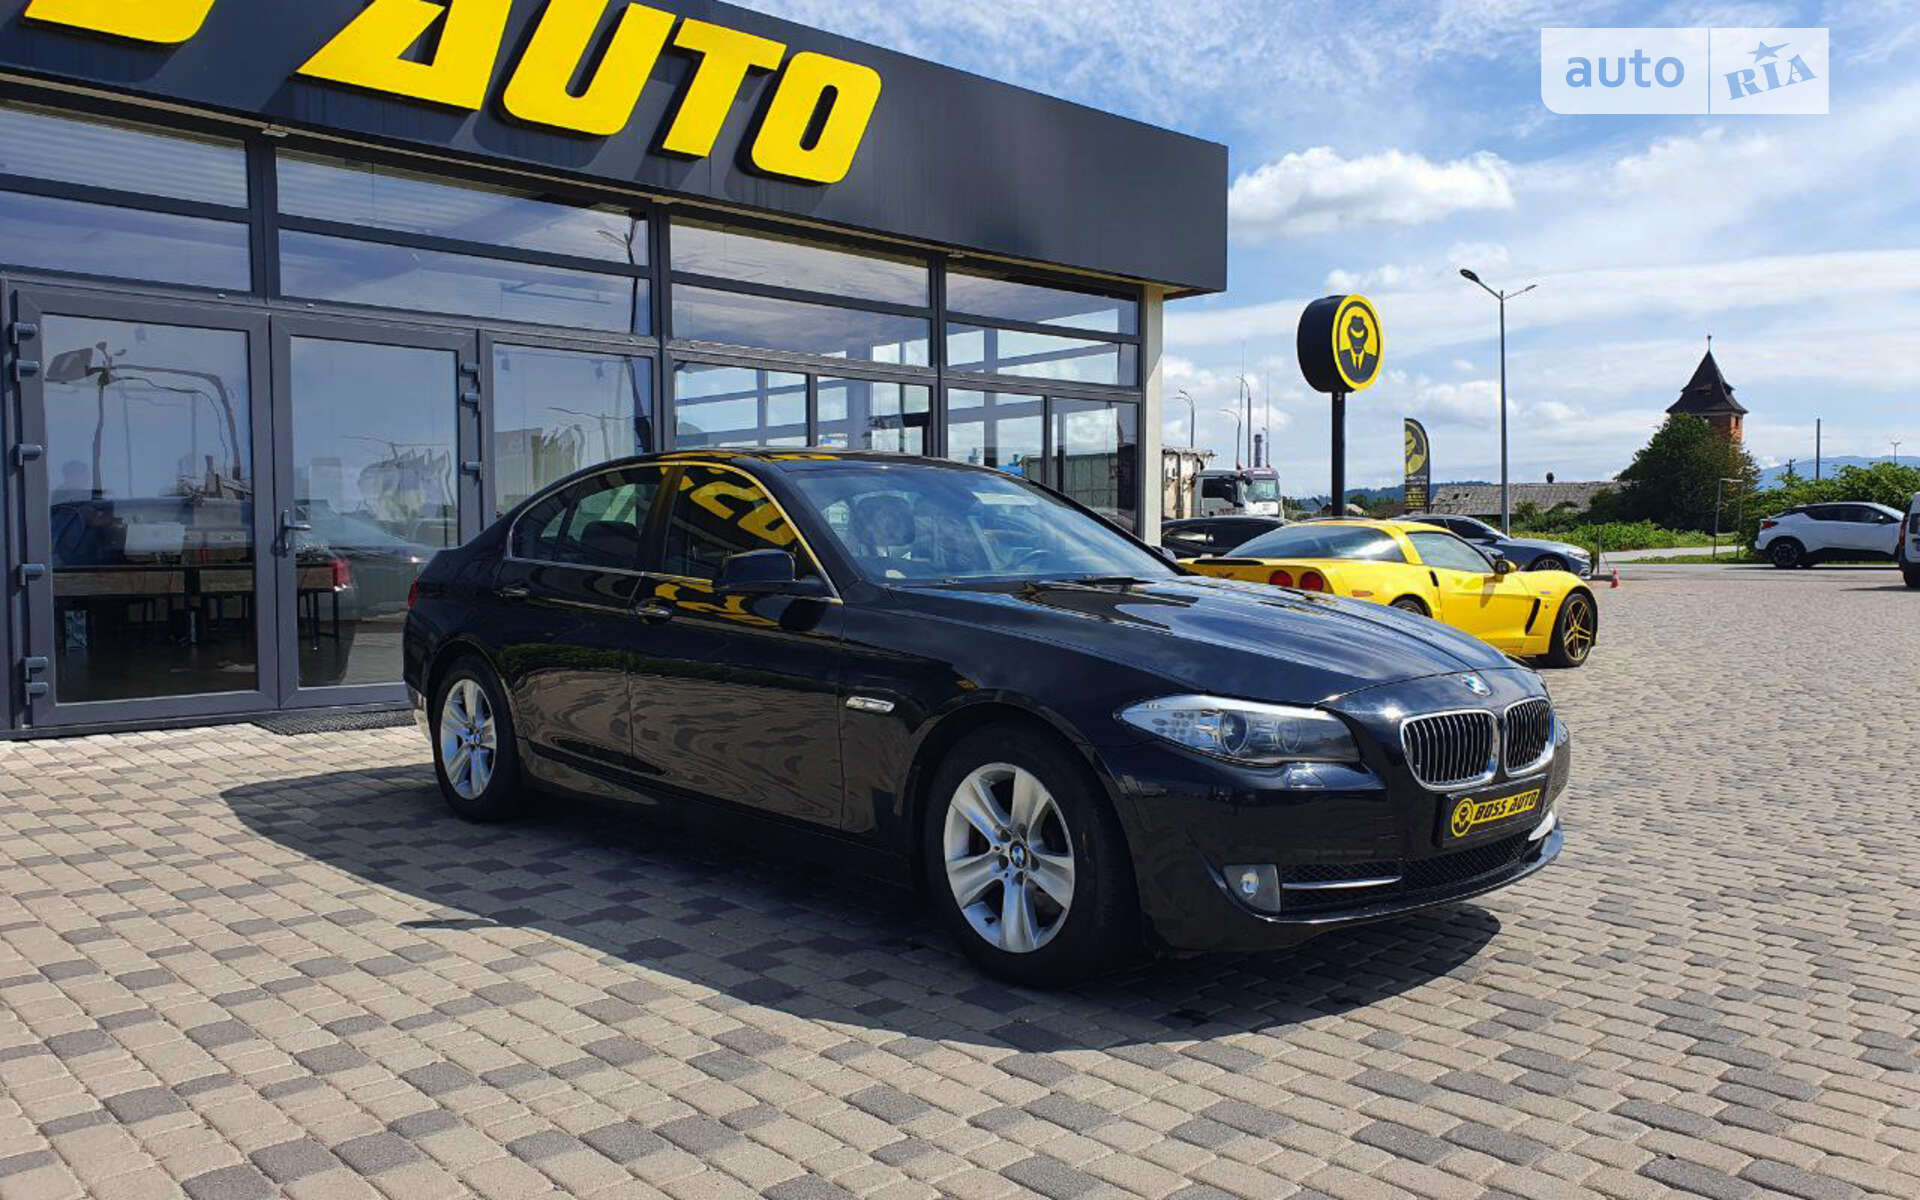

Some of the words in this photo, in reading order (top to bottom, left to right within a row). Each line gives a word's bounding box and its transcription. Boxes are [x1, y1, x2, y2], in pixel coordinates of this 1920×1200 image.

[294, 0, 882, 184] AUTO
[1474, 801, 1507, 820] BOSS
[1509, 791, 1537, 812] AUTO
